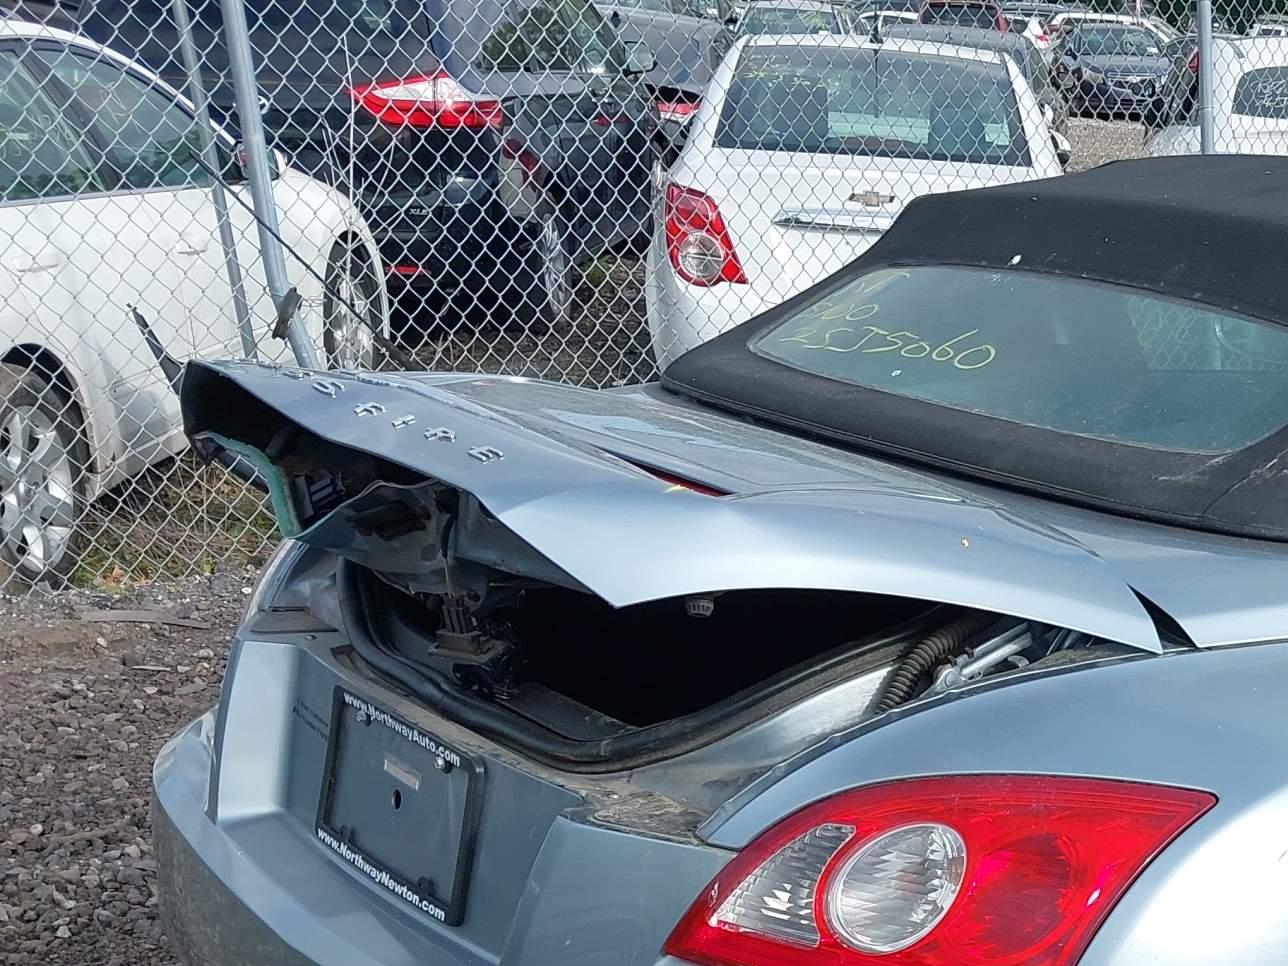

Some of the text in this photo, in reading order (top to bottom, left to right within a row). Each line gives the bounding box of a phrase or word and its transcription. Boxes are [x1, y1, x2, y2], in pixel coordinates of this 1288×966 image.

[778, 328, 996, 369] 25J5060
[343, 691, 461, 768] www.NorthwayAuto.com
[317, 827, 446, 922] www.NorthwayNewton.com
